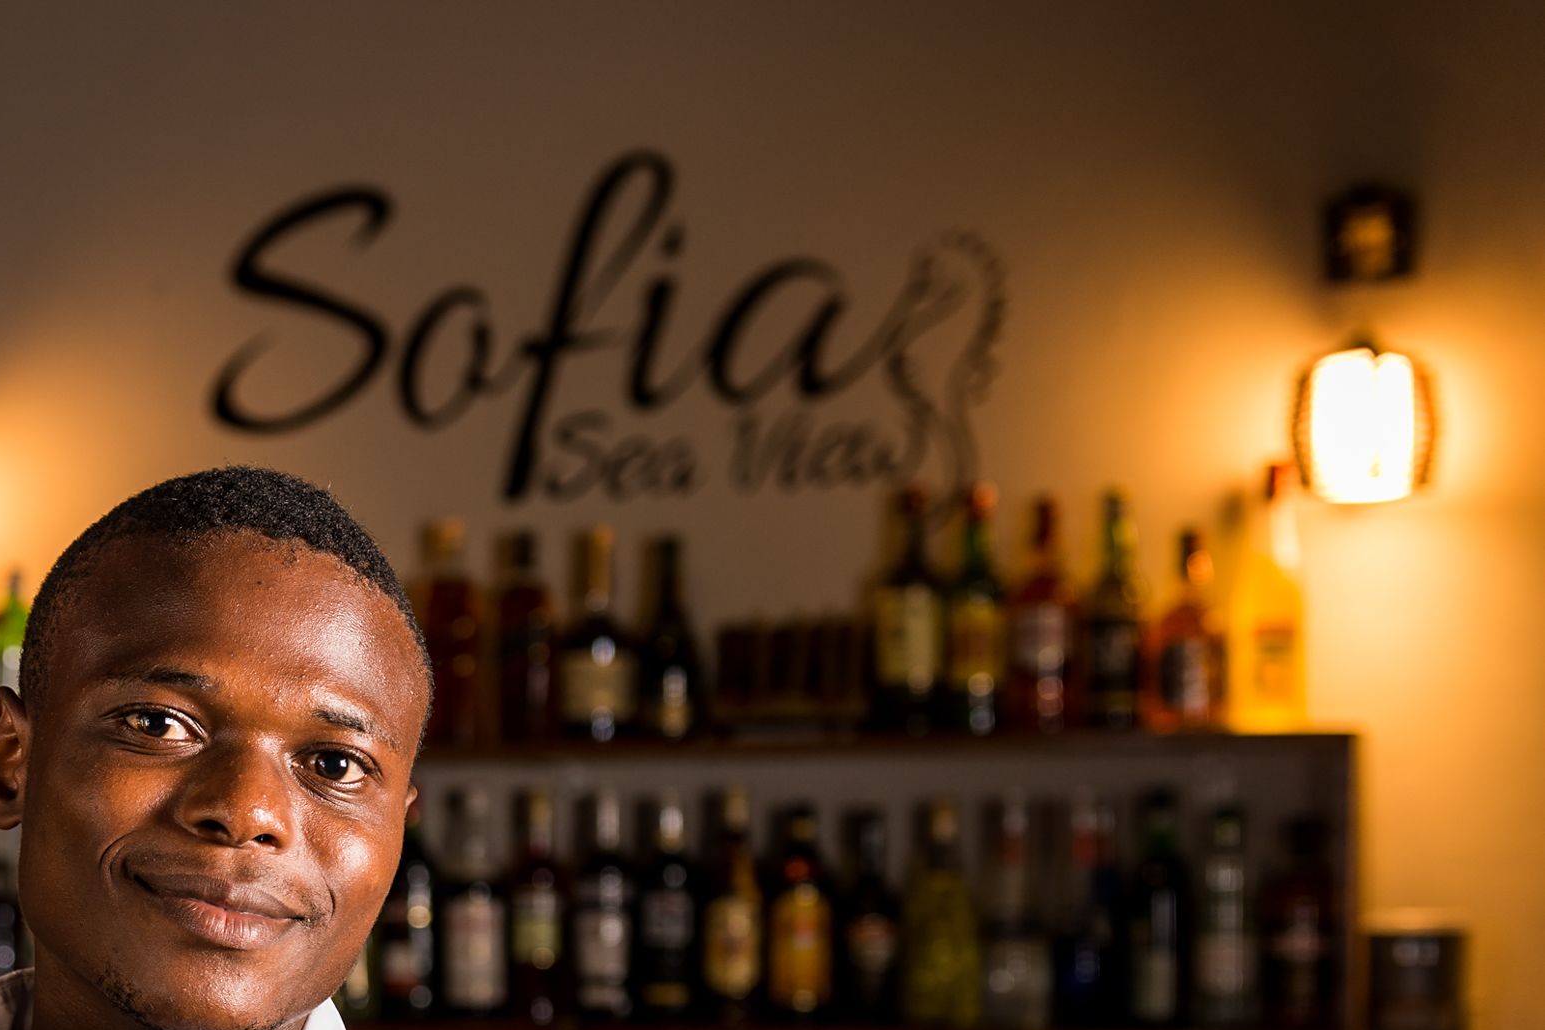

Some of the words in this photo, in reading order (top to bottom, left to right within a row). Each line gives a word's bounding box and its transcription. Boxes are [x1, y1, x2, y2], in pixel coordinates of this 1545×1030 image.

[209, 147, 887, 506] Sofia
[540, 410, 699, 501] Sea
[727, 406, 913, 492] View
